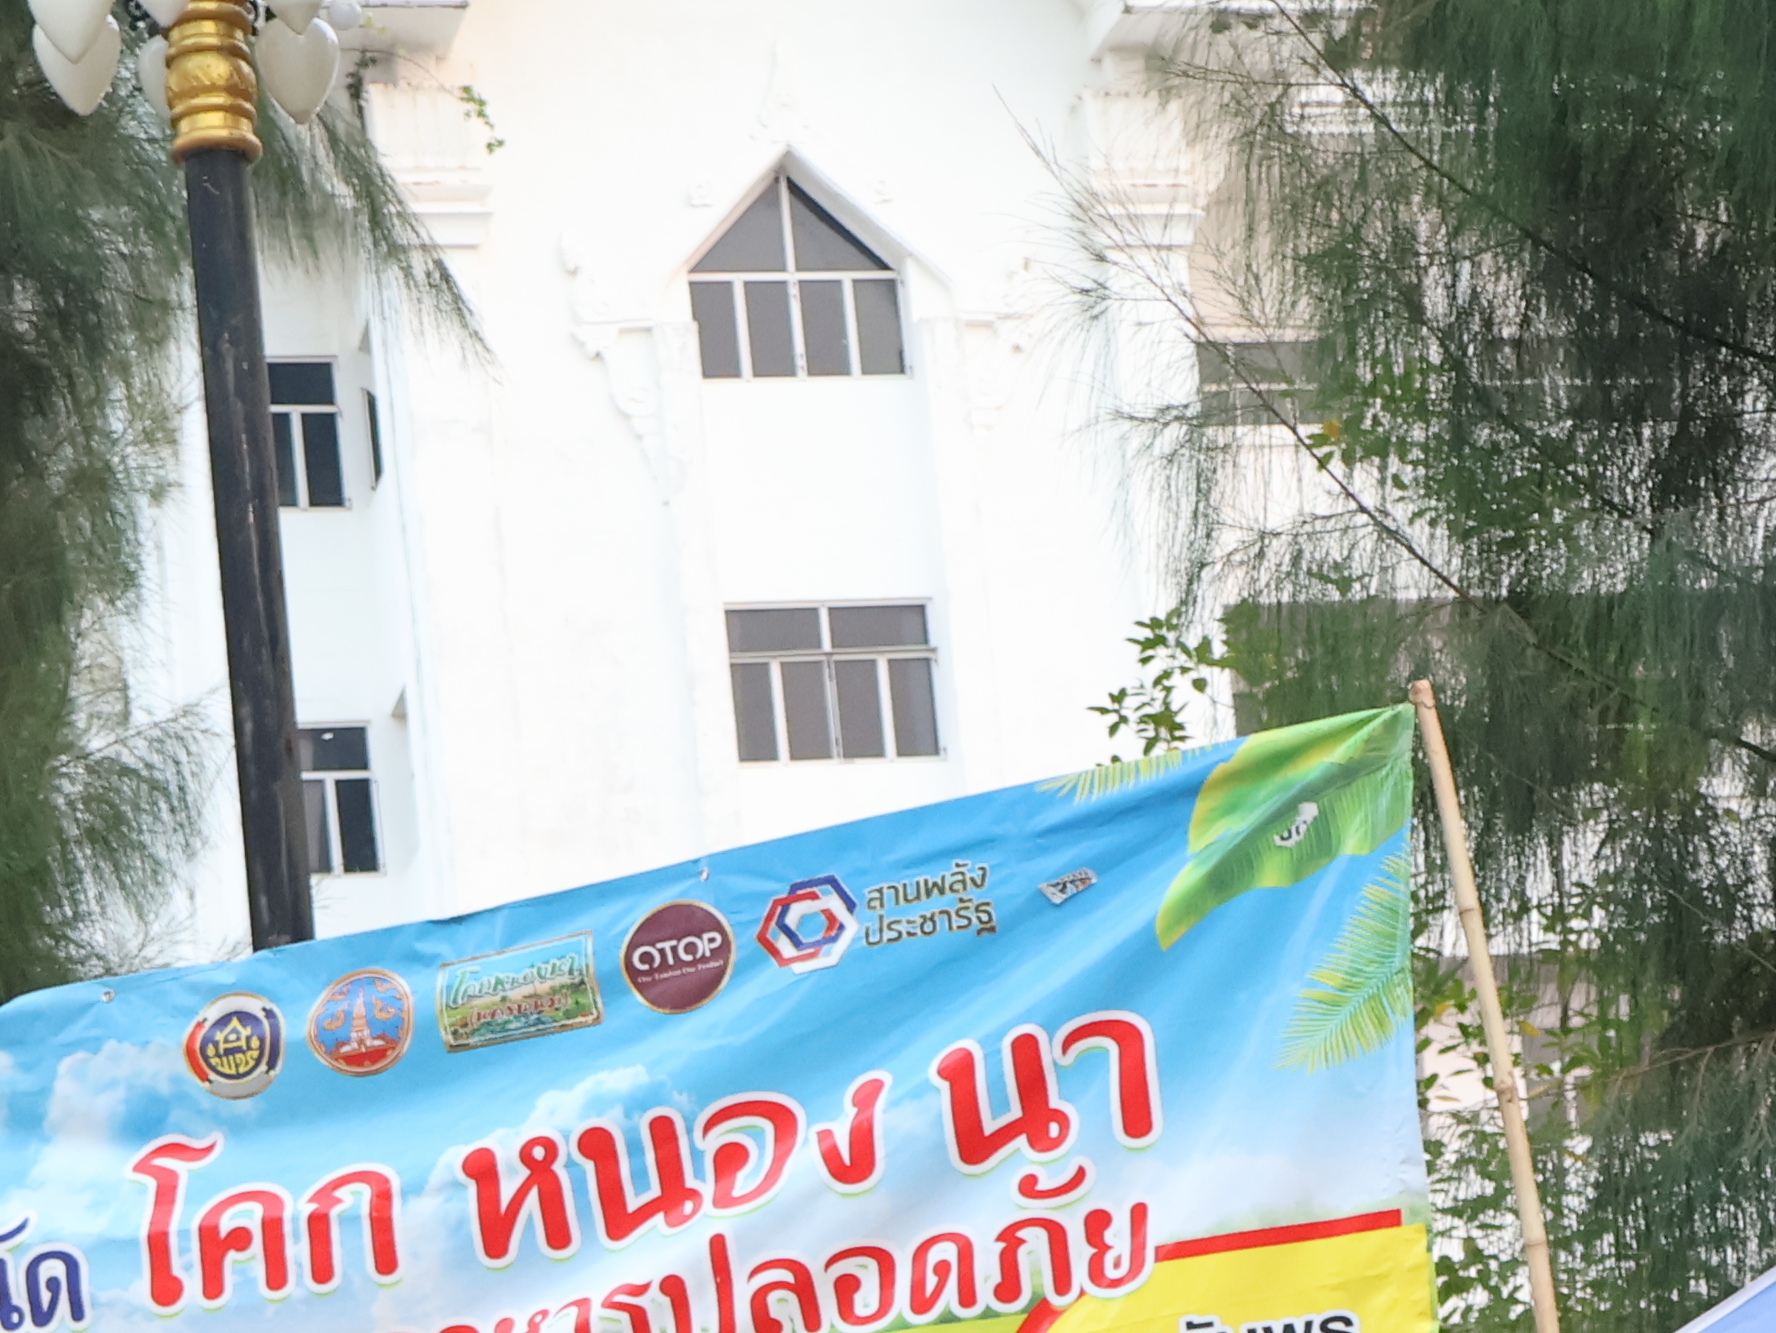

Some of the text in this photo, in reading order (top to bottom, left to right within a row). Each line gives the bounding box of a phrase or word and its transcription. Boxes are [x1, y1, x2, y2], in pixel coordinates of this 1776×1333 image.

[866, 861, 988, 911] สานพลัง
[865, 897, 997, 947] ประชารัฐ
[632, 931, 723, 971] OTOP
[132, 1019, 1155, 1308] โคก หนอง นา
